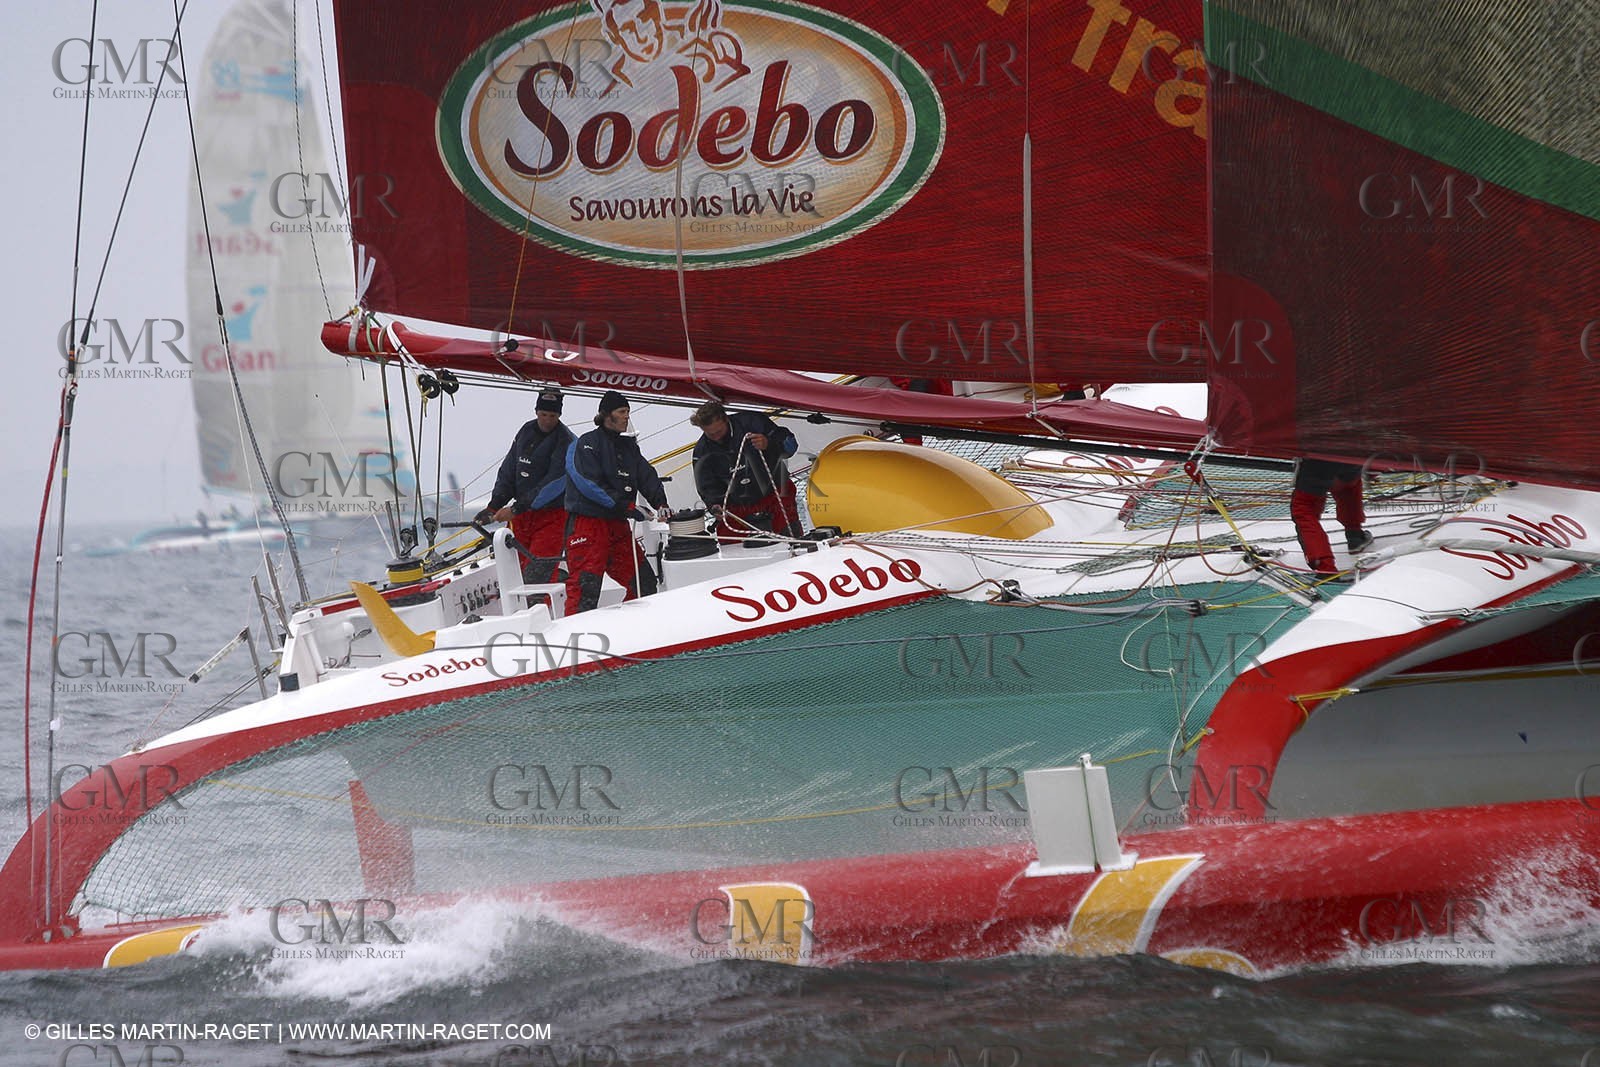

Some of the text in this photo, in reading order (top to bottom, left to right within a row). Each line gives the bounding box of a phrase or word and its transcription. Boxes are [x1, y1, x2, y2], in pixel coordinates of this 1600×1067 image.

[504, 60, 878, 181] Sodebo
[569, 183, 815, 222] Savourons la Vie
[711, 559, 922, 622] Sodebo
[381, 657, 488, 687] Sodebo
